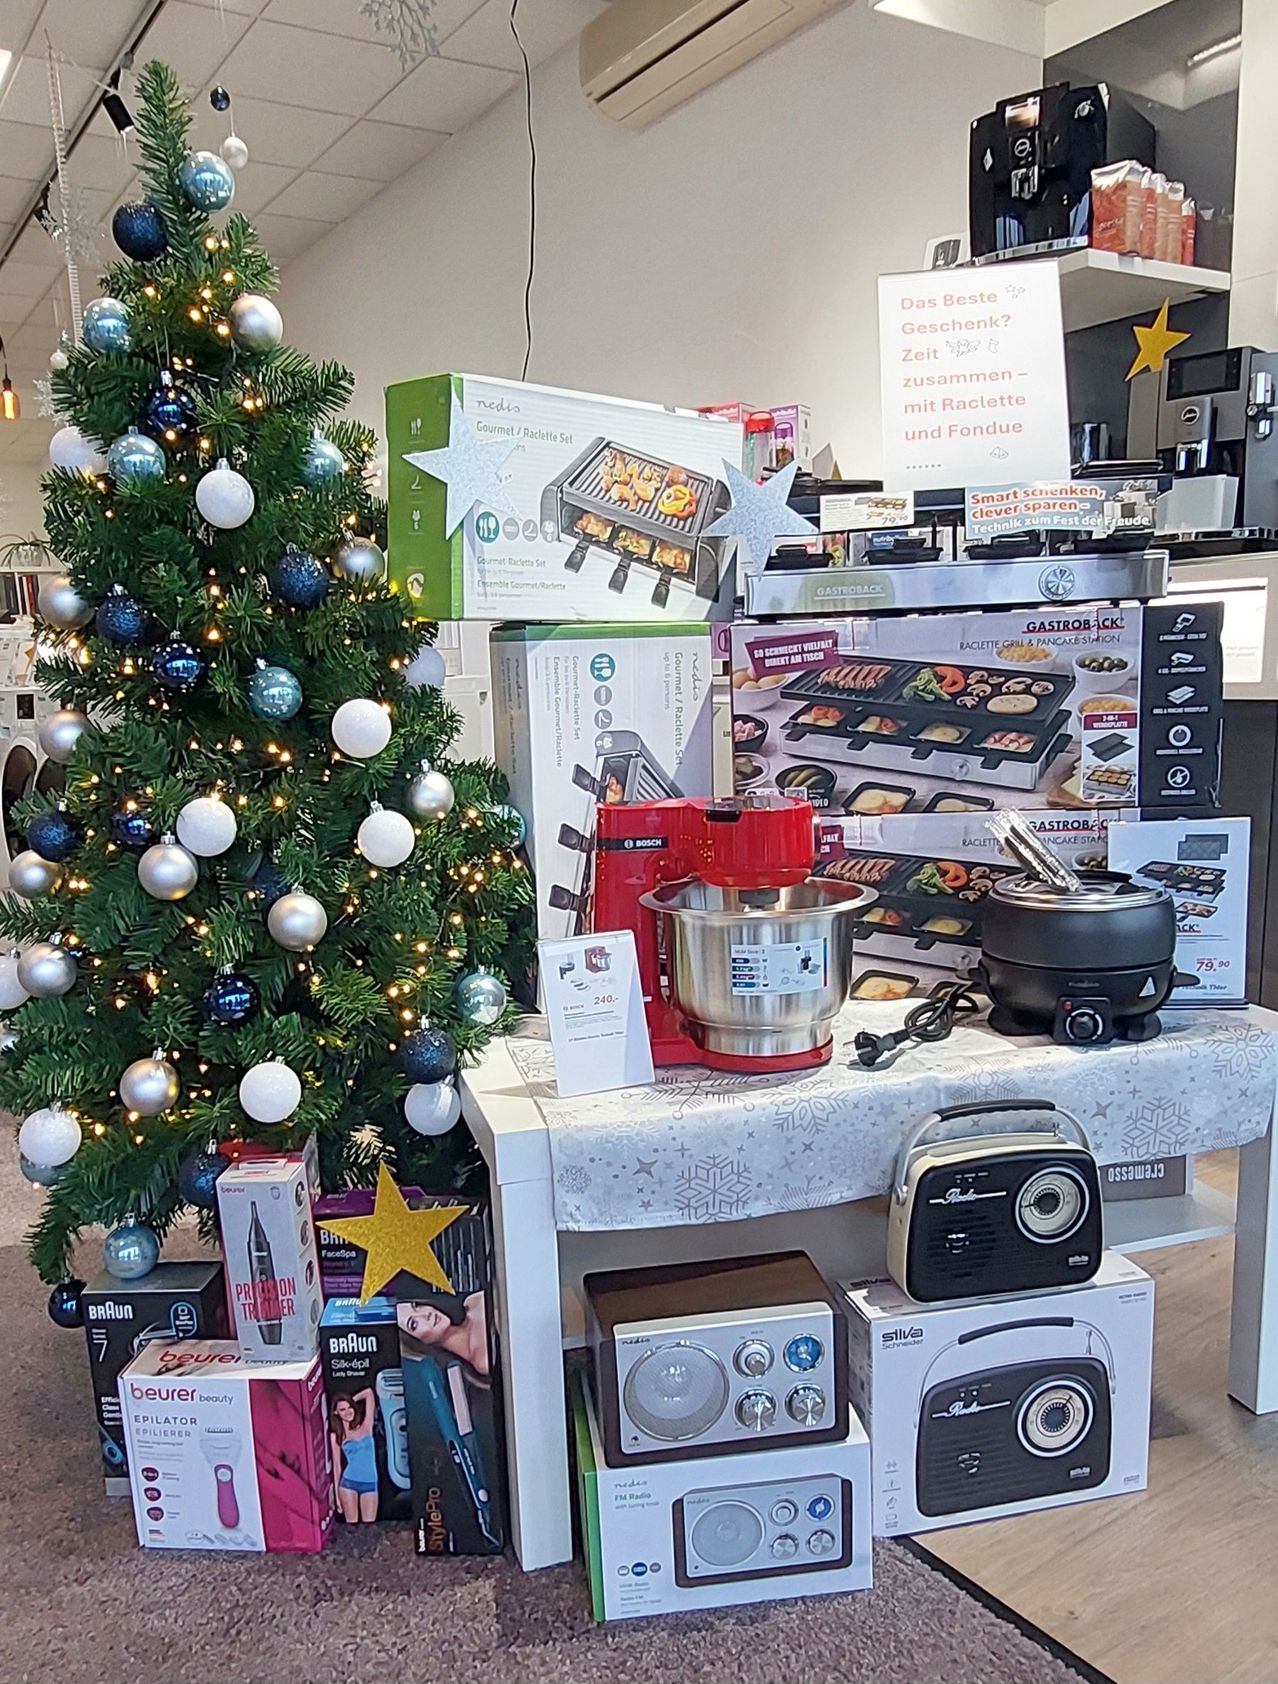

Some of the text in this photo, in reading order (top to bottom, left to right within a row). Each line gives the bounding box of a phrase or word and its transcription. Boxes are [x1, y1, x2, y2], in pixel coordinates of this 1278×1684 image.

[901, 292, 998, 310] Das Beste
[901, 314, 1011, 335] Geschenk?
[902, 348, 939, 362] Zeit
[903, 369, 1012, 388] zusammen
[476, 397, 520, 413] nedis
[904, 393, 1026, 414] mit Raclette
[476, 421, 514, 436] Gourmet
[523, 427, 558, 442] Raclette
[559, 433, 573, 444] Set
[905, 421, 1023, 441] und Fondue
[971, 485, 1105, 505] Smart schenken,
[972, 505, 1019, 520] clever
[1023, 501, 1078, 516] sparen
[972, 519, 1022, 534] Technik
[1025, 516, 1050, 526] zum
[1054, 515, 1079, 526] Fest
[1082, 514, 1101, 526] der
[816, 584, 883, 596] GASTROBACK
[803, 639, 833, 652] VIELFALT
[960, 635, 1120, 650] RACLETTE GRILL & PANCAKE STATION
[674, 652, 683, 696] Gourmet
[692, 652, 702, 701] nedis
[675, 706, 683, 747] Raclette
[675, 750, 683, 766] Set
[636, 839, 661, 847] BOSCH
[594, 994, 619, 1005] 240.-
[1108, 1163, 1164, 1182] cremesso
[322, 1250, 356, 1258] FaceSpa
[89, 1301, 133, 1320] BRAUN
[329, 1333, 377, 1353] BRAUN
[622, 1337, 651, 1345] nedis
[882, 1326, 923, 1342] silva
[93, 1340, 107, 1362] 7
[882, 1339, 923, 1350] Schneider
[130, 1382, 233, 1405] beurer beauty
[134, 1415, 198, 1426] EPILATOR
[136, 1428, 191, 1438] EPILIERER
[614, 1479, 647, 1489] nedis
[629, 1492, 651, 1501] Radio
[426, 1487, 448, 1551] StylePro
